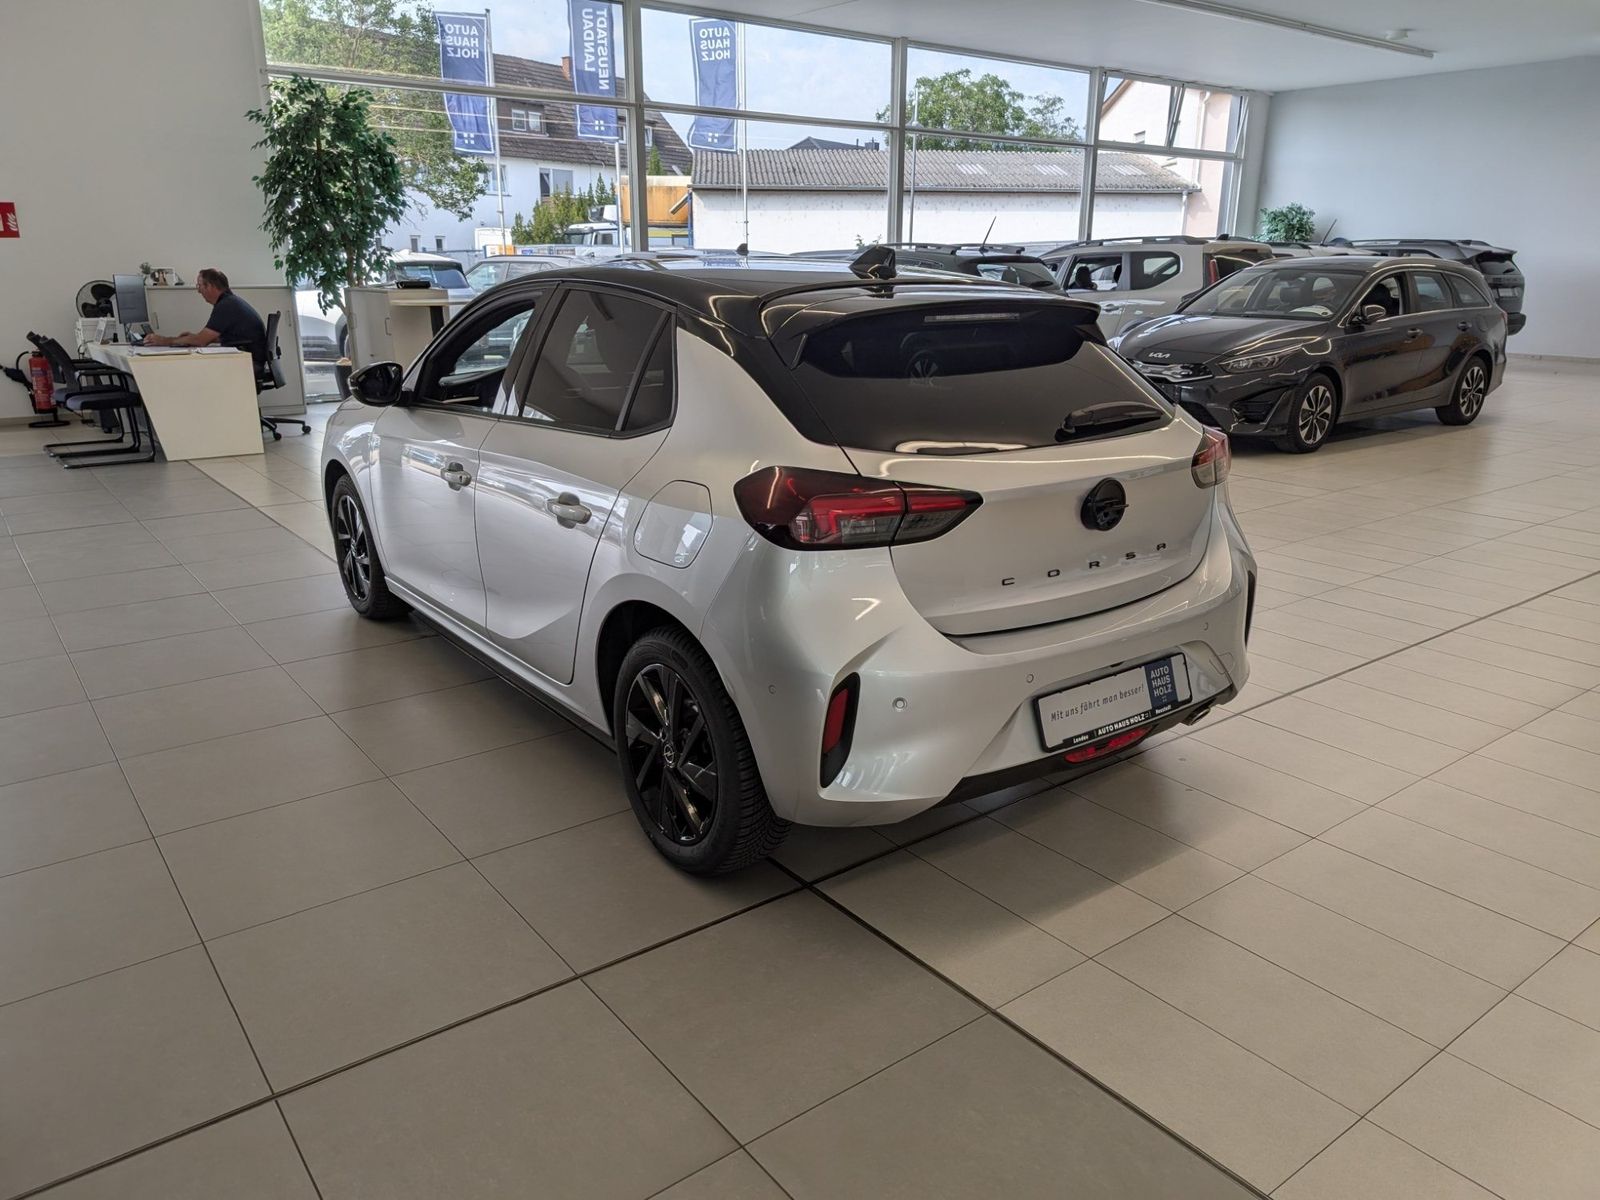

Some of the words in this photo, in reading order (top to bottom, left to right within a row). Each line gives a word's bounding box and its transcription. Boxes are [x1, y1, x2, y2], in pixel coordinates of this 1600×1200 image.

[1148, 351, 1171, 359] KIA
[1001, 542, 1167, 587] CORSA
[1150, 665, 1170, 679] AUTO
[1152, 674, 1171, 688] HAUS
[1153, 683, 1173, 697] HOLZ
[1050, 710, 1064, 722] Mit
[1065, 705, 1079, 718] uns
[1080, 698, 1101, 715] fährt
[1102, 693, 1118, 705] man
[1119, 683, 1145, 700] besser!
[1098, 725, 1114, 735] AUTO
[1114, 719, 1130, 730] HAUS
[1130, 713, 1145, 724] HOLZ
